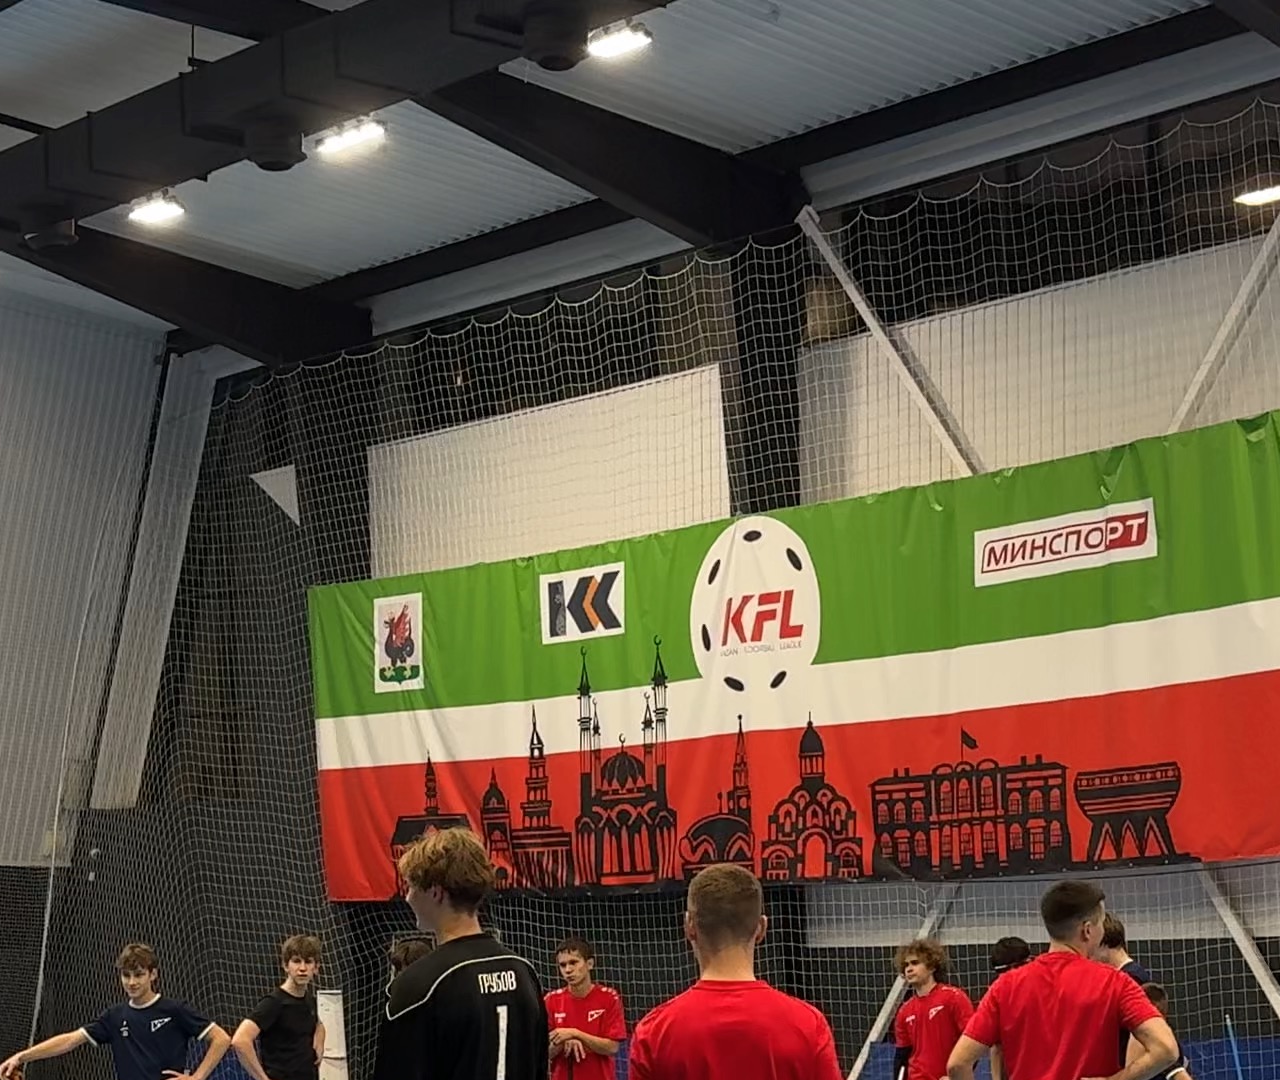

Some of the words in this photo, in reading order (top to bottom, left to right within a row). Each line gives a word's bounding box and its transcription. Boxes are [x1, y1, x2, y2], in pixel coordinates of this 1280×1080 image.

[987, 516, 1146, 568] МИНСПОРТ
[721, 589, 804, 647] KFL
[477, 970, 518, 994] ГРУБОВ
